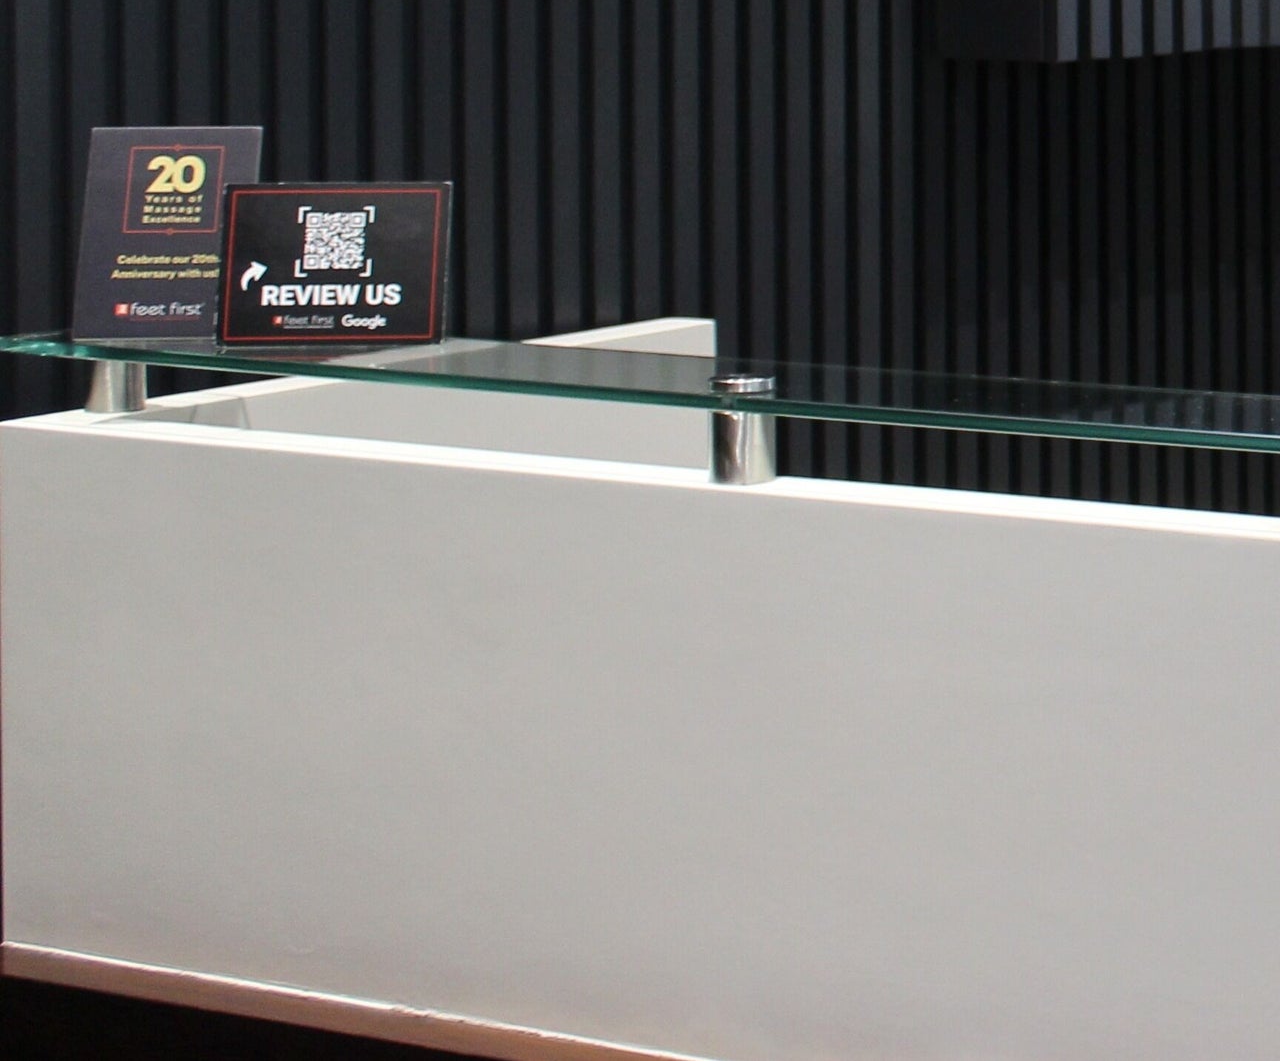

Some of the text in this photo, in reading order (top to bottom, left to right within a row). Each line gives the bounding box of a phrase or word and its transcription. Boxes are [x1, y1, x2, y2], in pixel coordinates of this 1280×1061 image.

[145, 154, 206, 193] 20
[145, 194, 203, 204] Years of
[143, 205, 202, 215] Massage
[142, 215, 201, 224] Excellence
[117, 255, 171, 264] Celebrate
[111, 270, 177, 280] Anniversary
[261, 283, 402, 306] REVIEW US
[130, 301, 203, 315] feet first
[341, 314, 387, 330] Google
